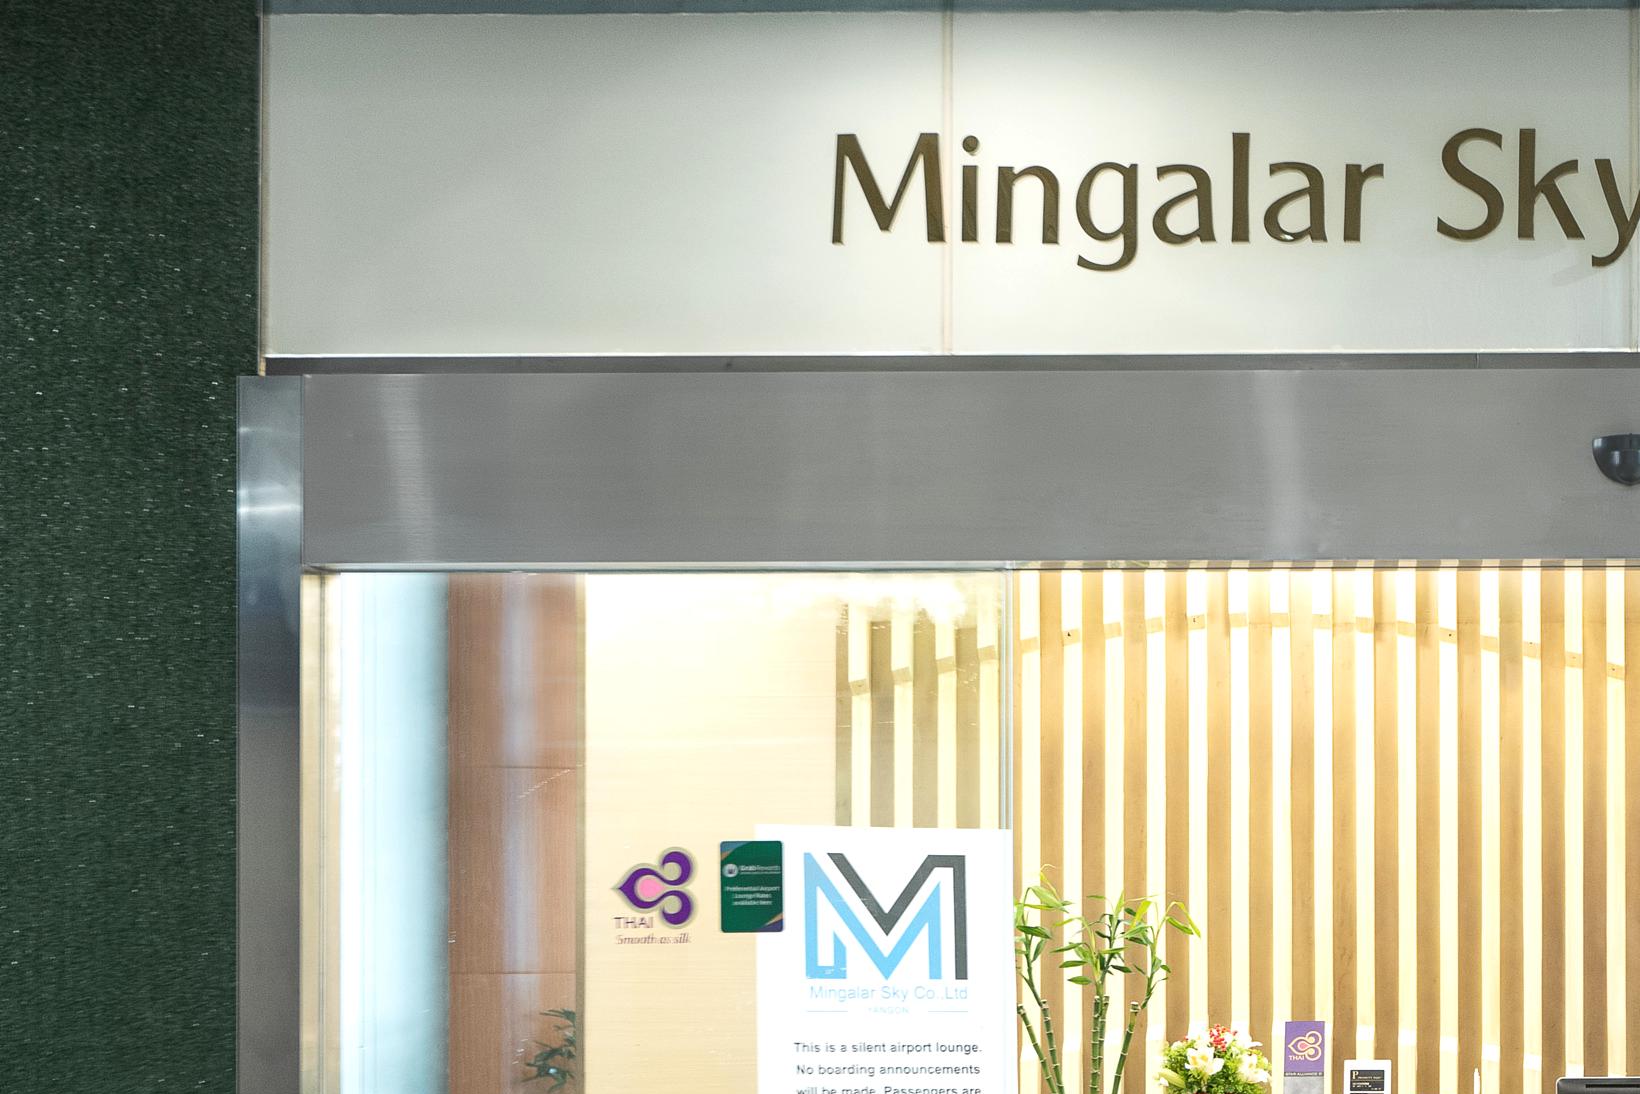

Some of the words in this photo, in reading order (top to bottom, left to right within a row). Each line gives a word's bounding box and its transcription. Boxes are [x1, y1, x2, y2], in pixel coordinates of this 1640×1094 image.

[832, 132, 1384, 271] Mingalar
[613, 917, 654, 929] THAI
[809, 985, 876, 1003] Mingalar
[881, 985, 909, 1002] Sky
[793, 1042, 821, 1053] This
[825, 1042, 836, 1053] is
[840, 1044, 847, 1053] a
[851, 1042, 887, 1053] silent
[889, 1042, 932, 1055] airport
[936, 1042, 982, 1055] lounge.
[796, 1064, 814, 1075] No
[818, 1064, 876, 1078] boarding
[879, 1064, 981, 1075] announcements
